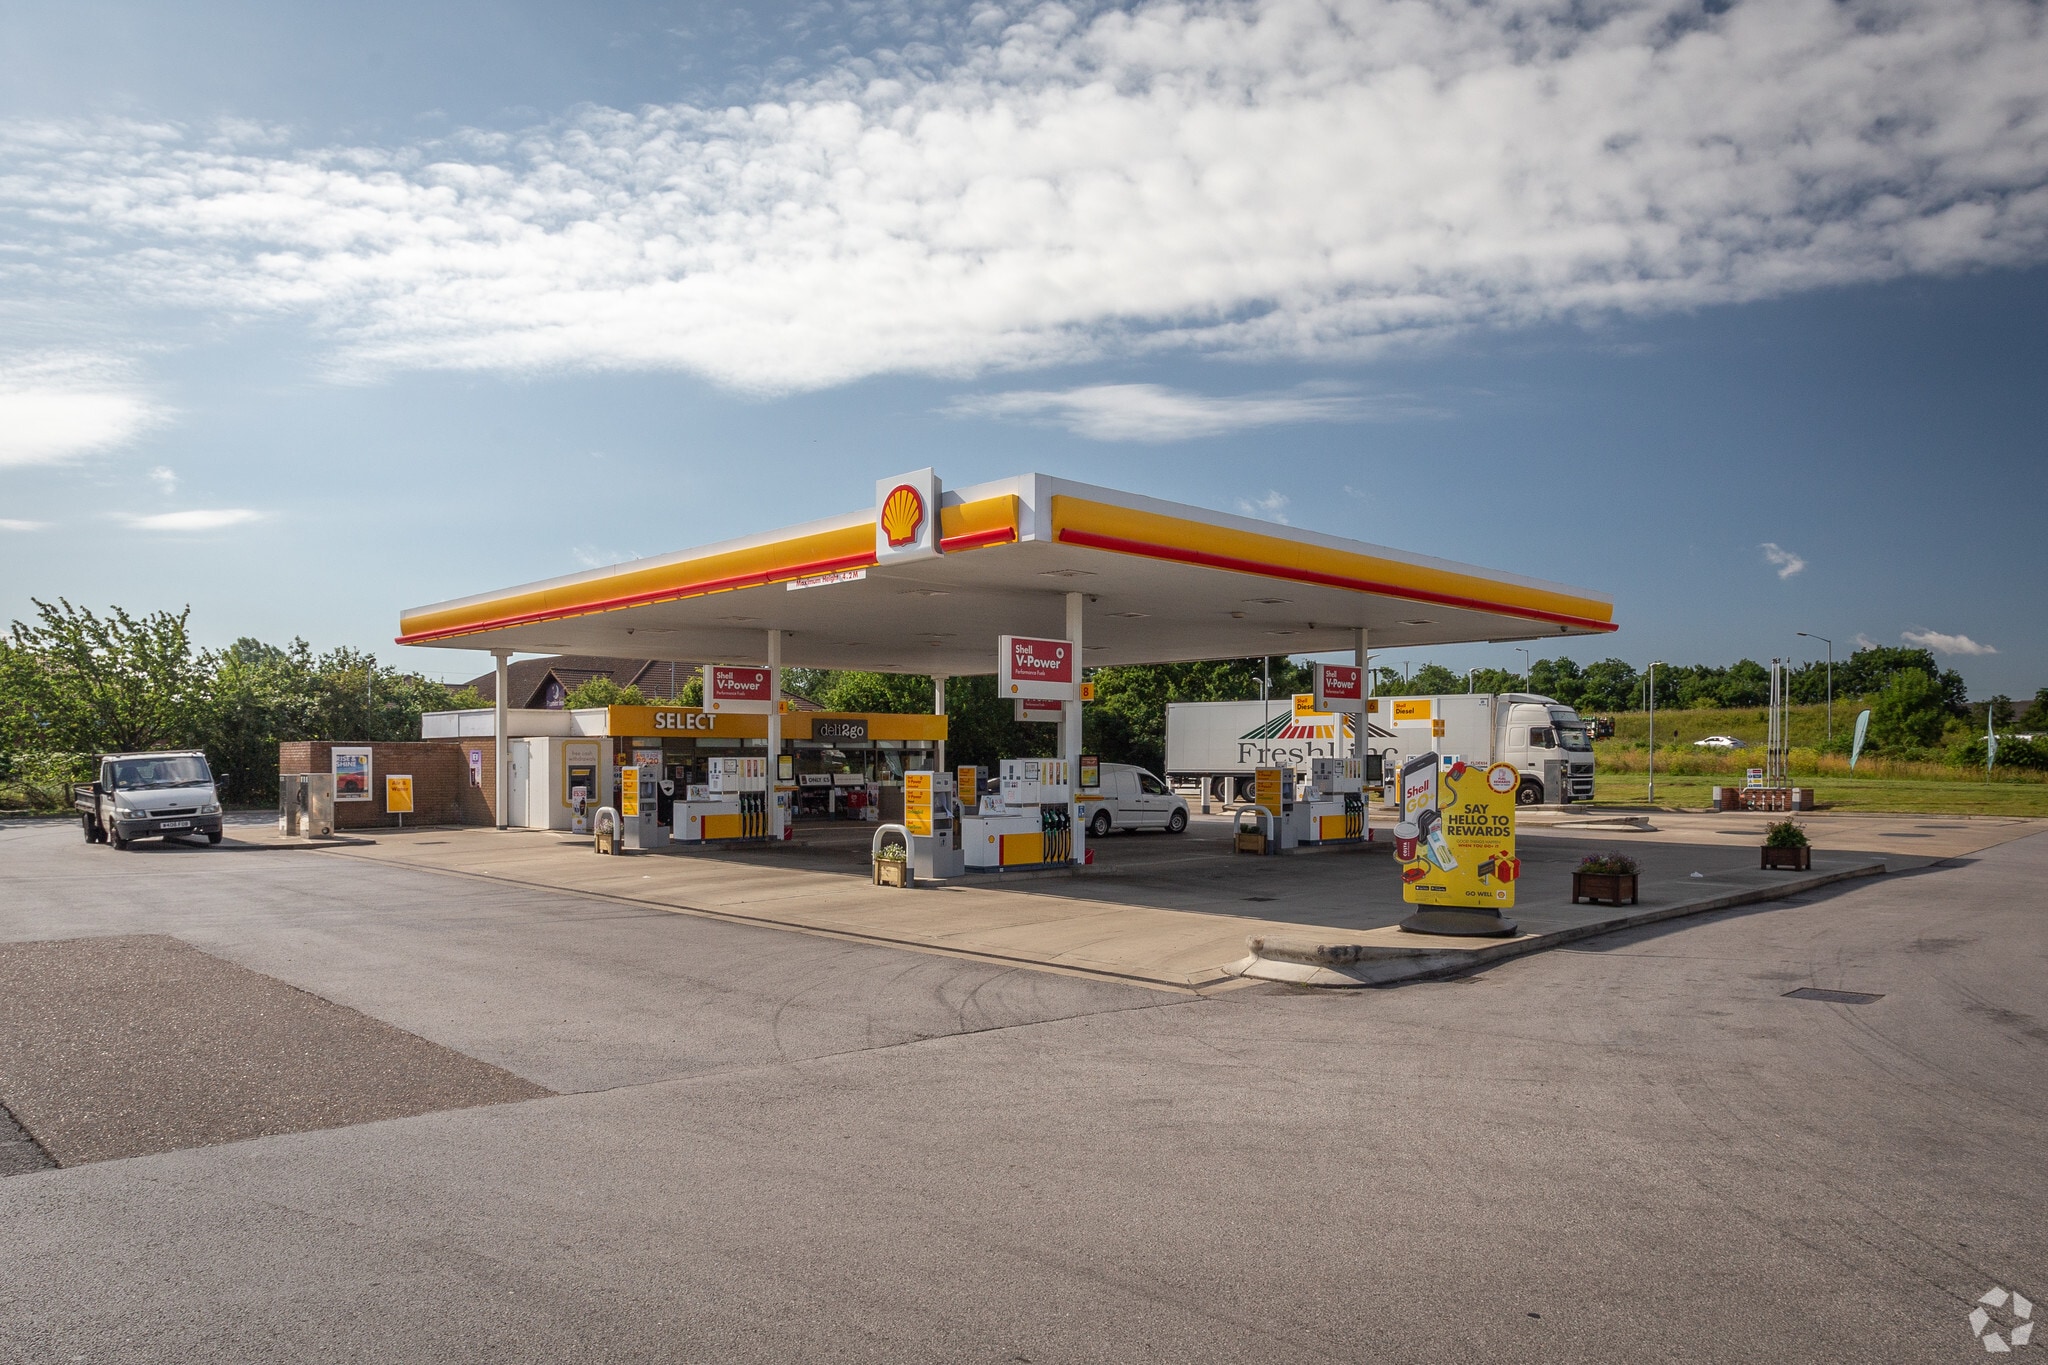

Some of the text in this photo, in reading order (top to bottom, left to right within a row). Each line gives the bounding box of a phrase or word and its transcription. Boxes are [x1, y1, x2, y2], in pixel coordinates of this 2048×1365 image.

[796, 570, 859, 587] Maximum Height 4.2M
[1016, 644, 1033, 654] Shell
[1016, 654, 1060, 669] V-Power
[716, 672, 734, 680] Shell
[717, 680, 760, 690] V-Power
[1326, 678, 1354, 689] V-Power
[1083, 686, 1089, 696] 8
[655, 712, 716, 730] SELECT
[820, 723, 864, 739] deli2go
[1407, 780, 1429, 798] Shell
[1406, 793, 1435, 813] GO+
[1465, 804, 1489, 814] SAY
[1449, 815, 1510, 826] HELLO TO
[1448, 826, 1510, 837] REWARDS
